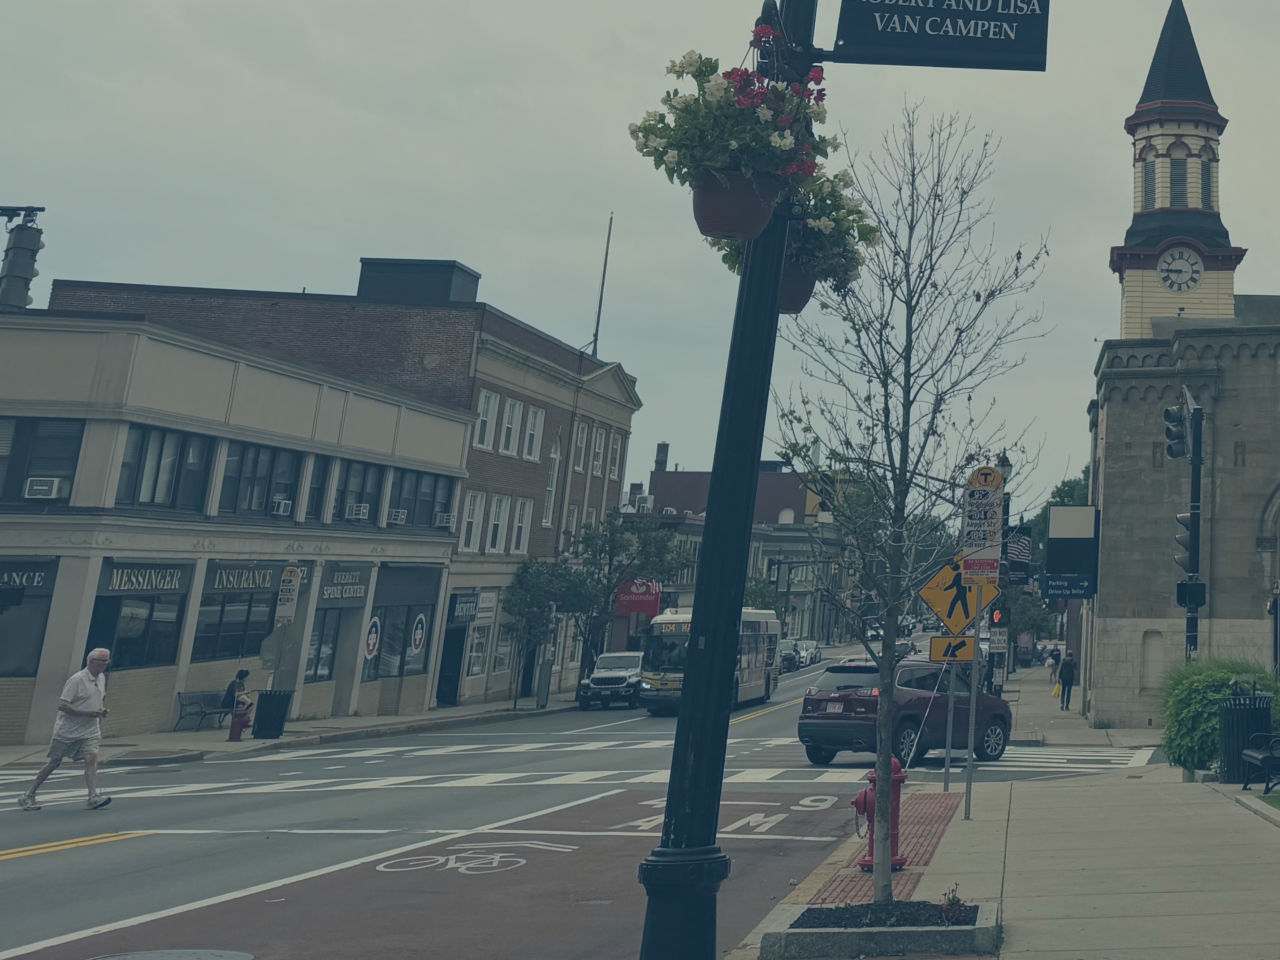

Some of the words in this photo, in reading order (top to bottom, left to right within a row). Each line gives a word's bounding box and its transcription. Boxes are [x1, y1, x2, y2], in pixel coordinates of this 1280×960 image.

[873, 12, 921, 34] VAN
[925, 16, 1018, 40] CAMPEN
[108, 569, 181, 590] MESSINGER
[214, 570, 272, 589] INSURANCE
[333, 571, 361, 583] EVERETT
[322, 586, 342, 599] SPINE
[342, 585, 366, 598] CENTER
[620, 593, 655, 601] Santander
[455, 602, 476, 616] DENTAL
[662, 624, 676, 632] 104
